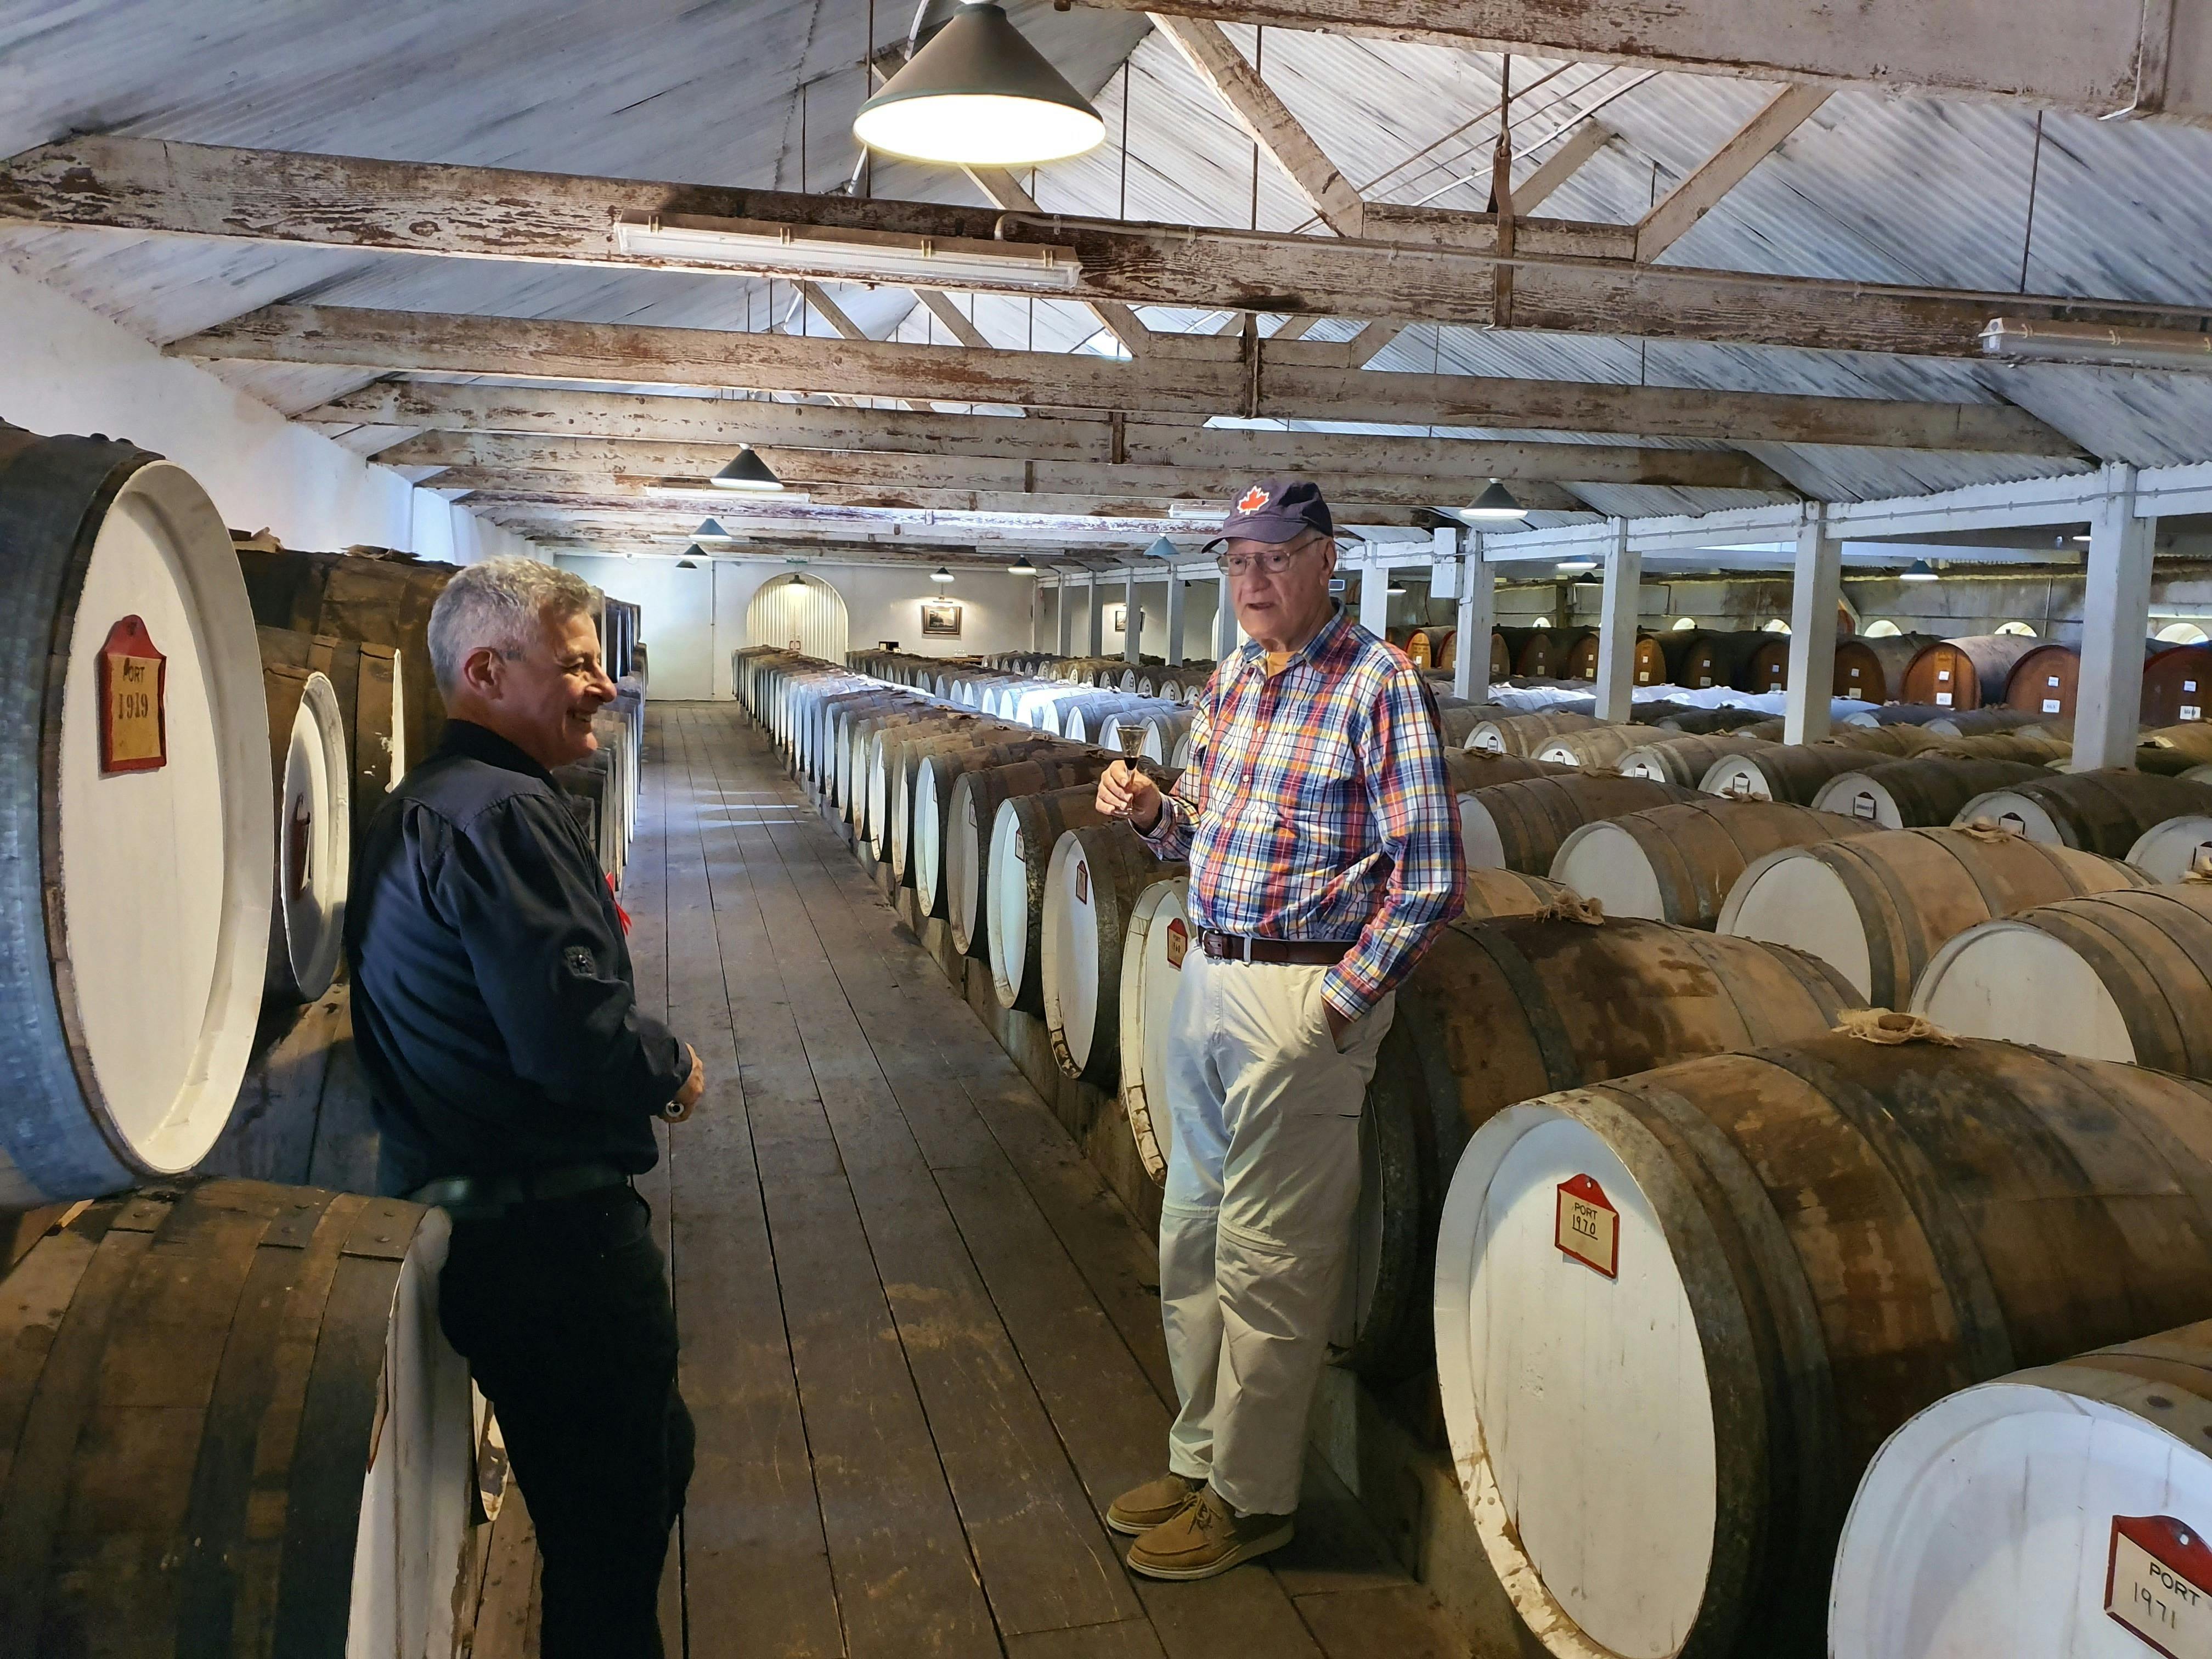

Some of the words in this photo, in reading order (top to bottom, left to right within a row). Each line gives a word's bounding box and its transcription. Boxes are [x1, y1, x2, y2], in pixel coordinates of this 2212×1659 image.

[1573, 1215, 1596, 1235] 1970
[1574, 1203, 1598, 1220] PORT
[2149, 1562, 2200, 1606] PORT
[2134, 1582, 2175, 1629] 1971
